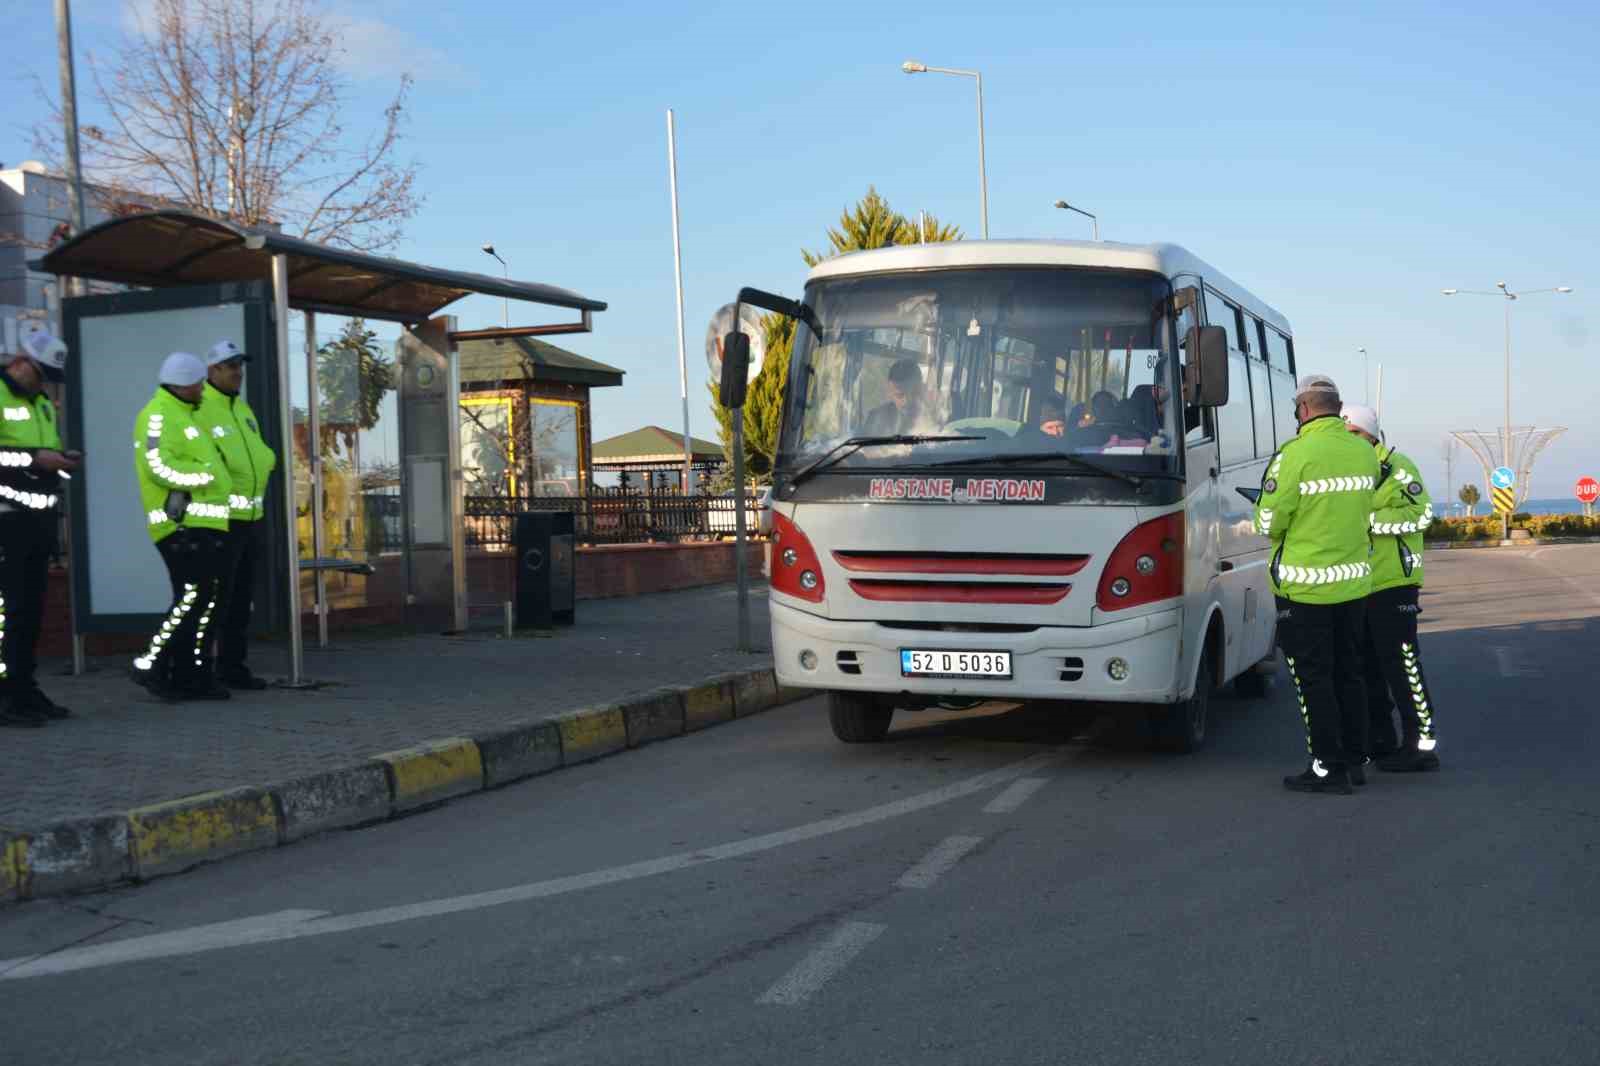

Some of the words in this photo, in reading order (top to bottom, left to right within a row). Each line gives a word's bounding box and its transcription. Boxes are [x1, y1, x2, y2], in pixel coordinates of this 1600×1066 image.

[870, 479, 953, 500] HASTANE
[967, 479, 1046, 500] MEYDAN
[1576, 484, 1598, 496] DUR
[912, 653, 934, 671] 52
[942, 654, 952, 671] D
[959, 654, 1004, 672] 5036
